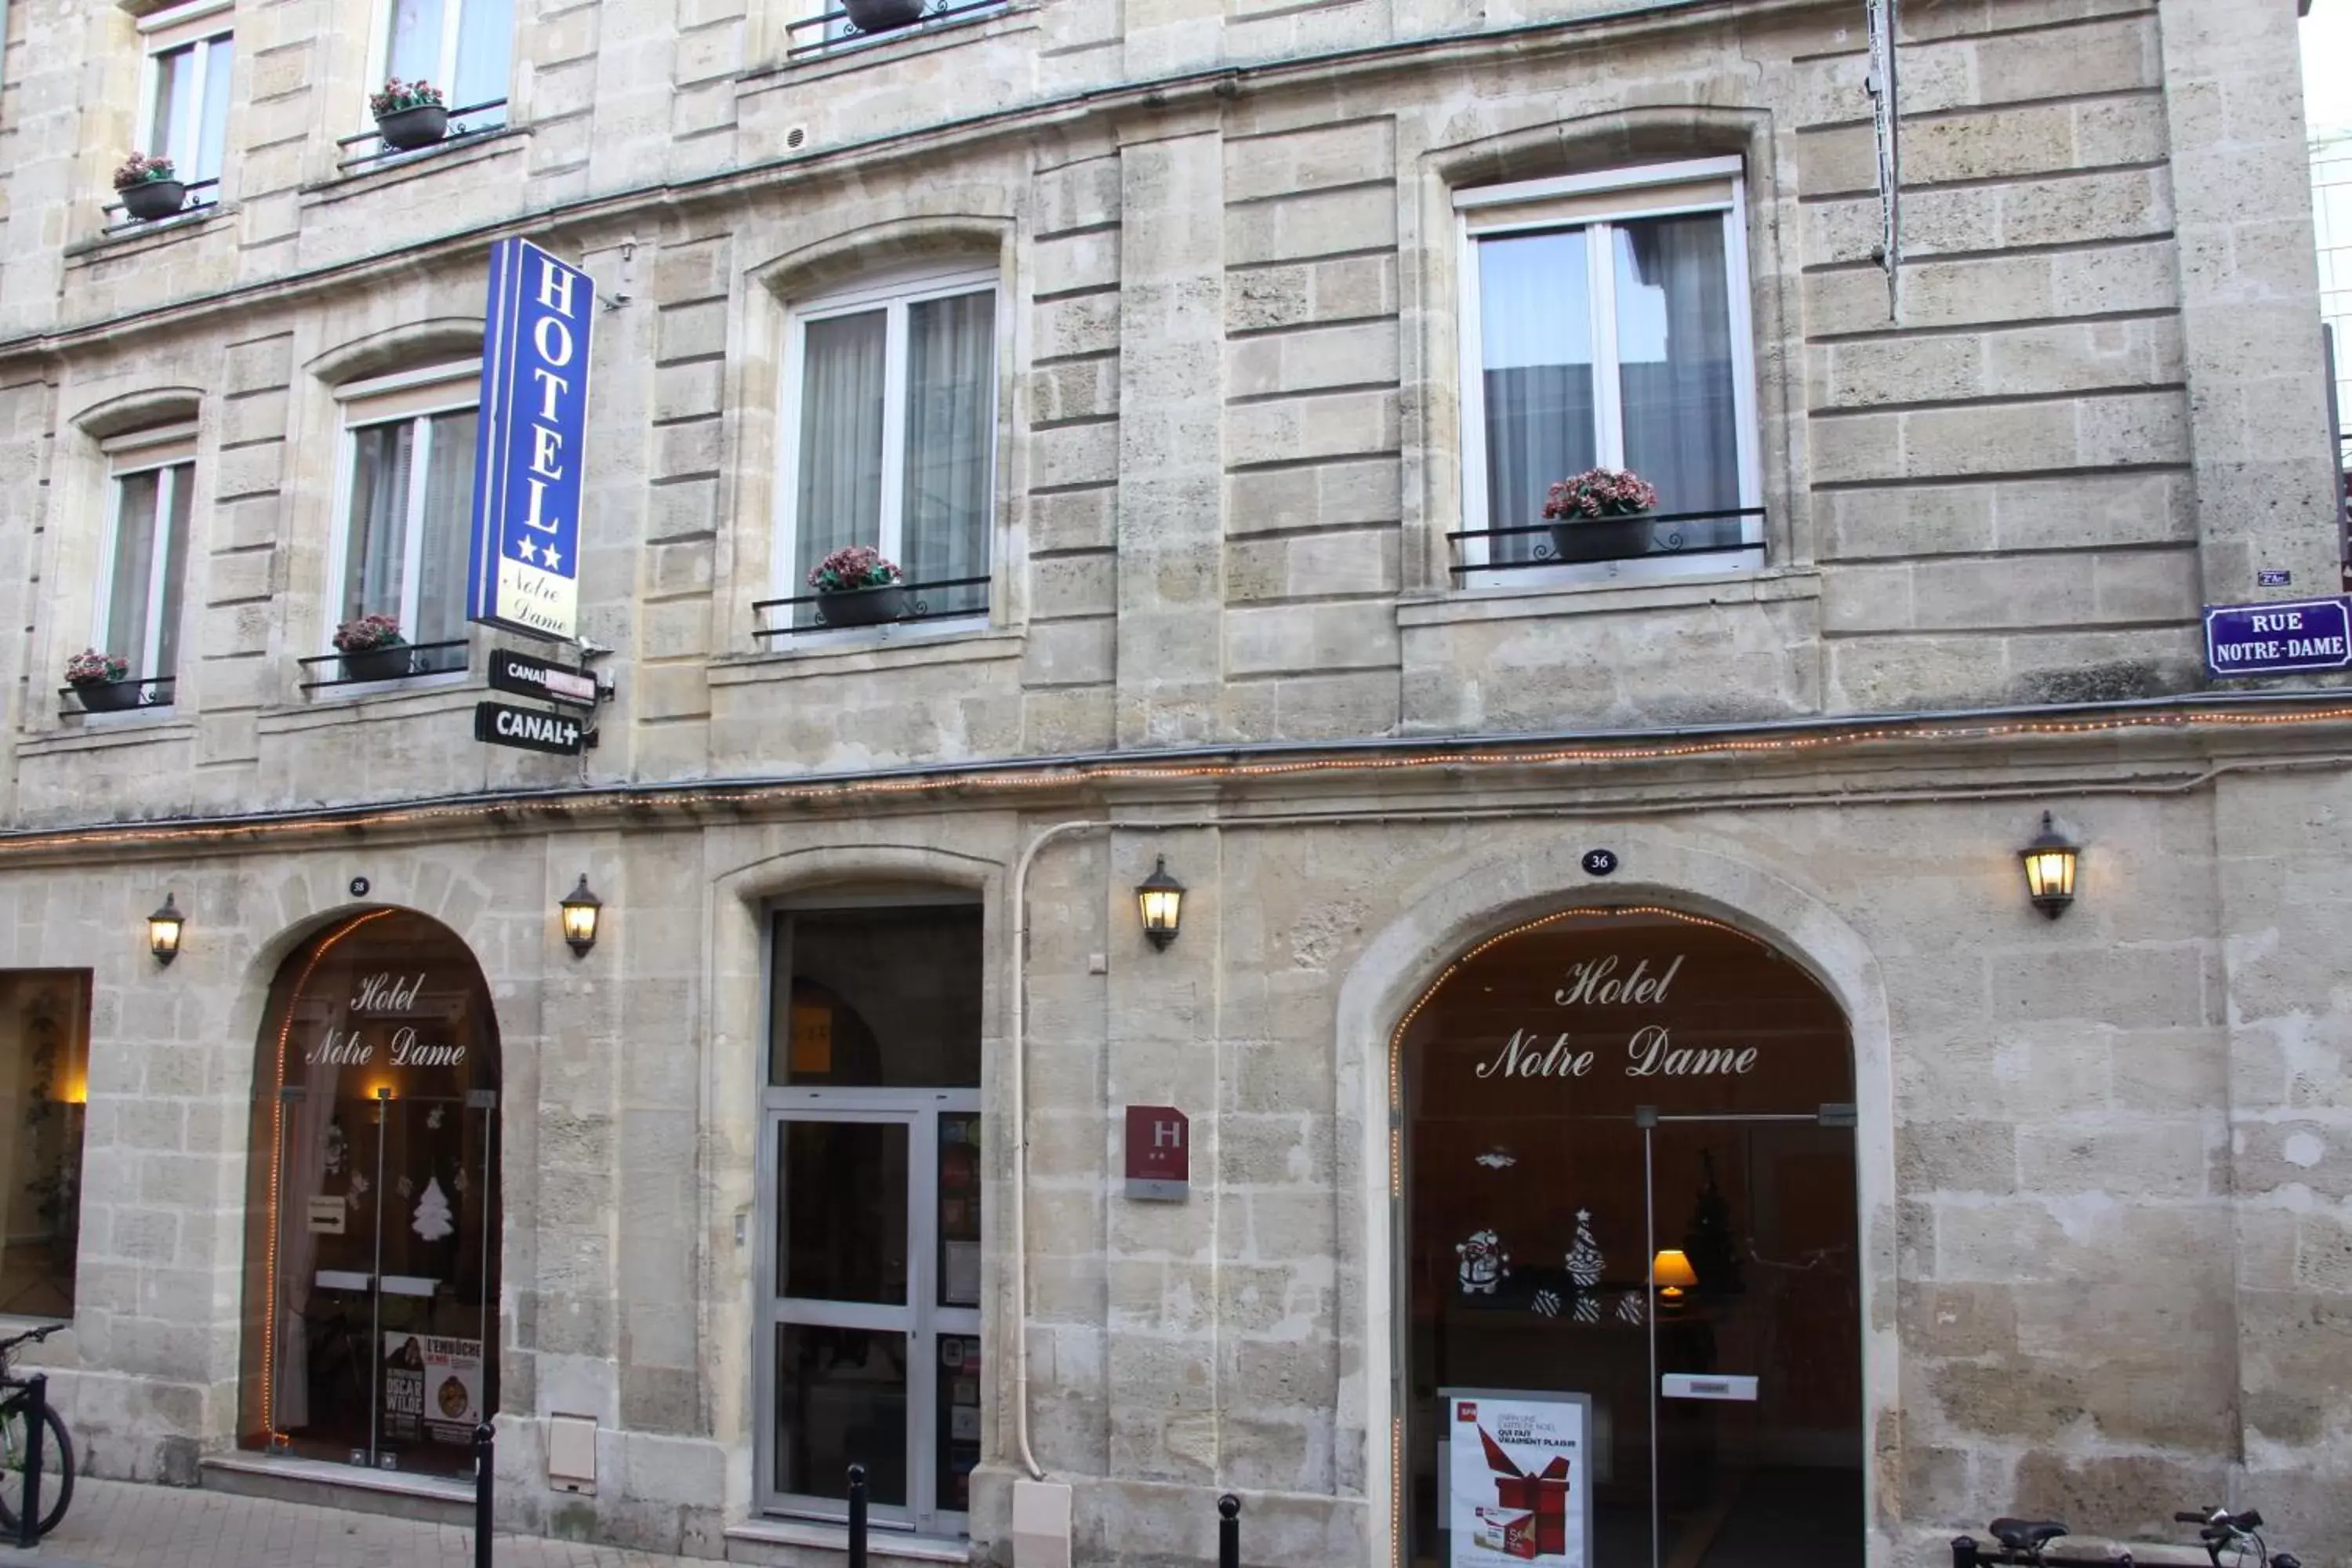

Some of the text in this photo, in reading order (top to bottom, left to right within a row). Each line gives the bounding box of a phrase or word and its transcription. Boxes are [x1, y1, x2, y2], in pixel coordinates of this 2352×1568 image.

[524, 256, 577, 535] HOTEL
[503, 568, 560, 603] Notre
[514, 597, 566, 630] Dame
[2252, 612, 2303, 633] RUE
[2216, 636, 2344, 662] NOTRE-DAME
[508, 663, 546, 684] CANAL
[496, 710, 579, 746] CANAL+
[1592, 855, 1608, 868] 36
[350, 972, 426, 1011] Hotel
[1555, 954, 1686, 1006] Hotel
[306, 1026, 466, 1067] Notre Dame
[1476, 1025, 1759, 1078] Notre Dame
[1154, 1120, 1180, 1148] H
[387, 1377, 422, 1397] OSCAR
[387, 1395, 422, 1414] WILDE
